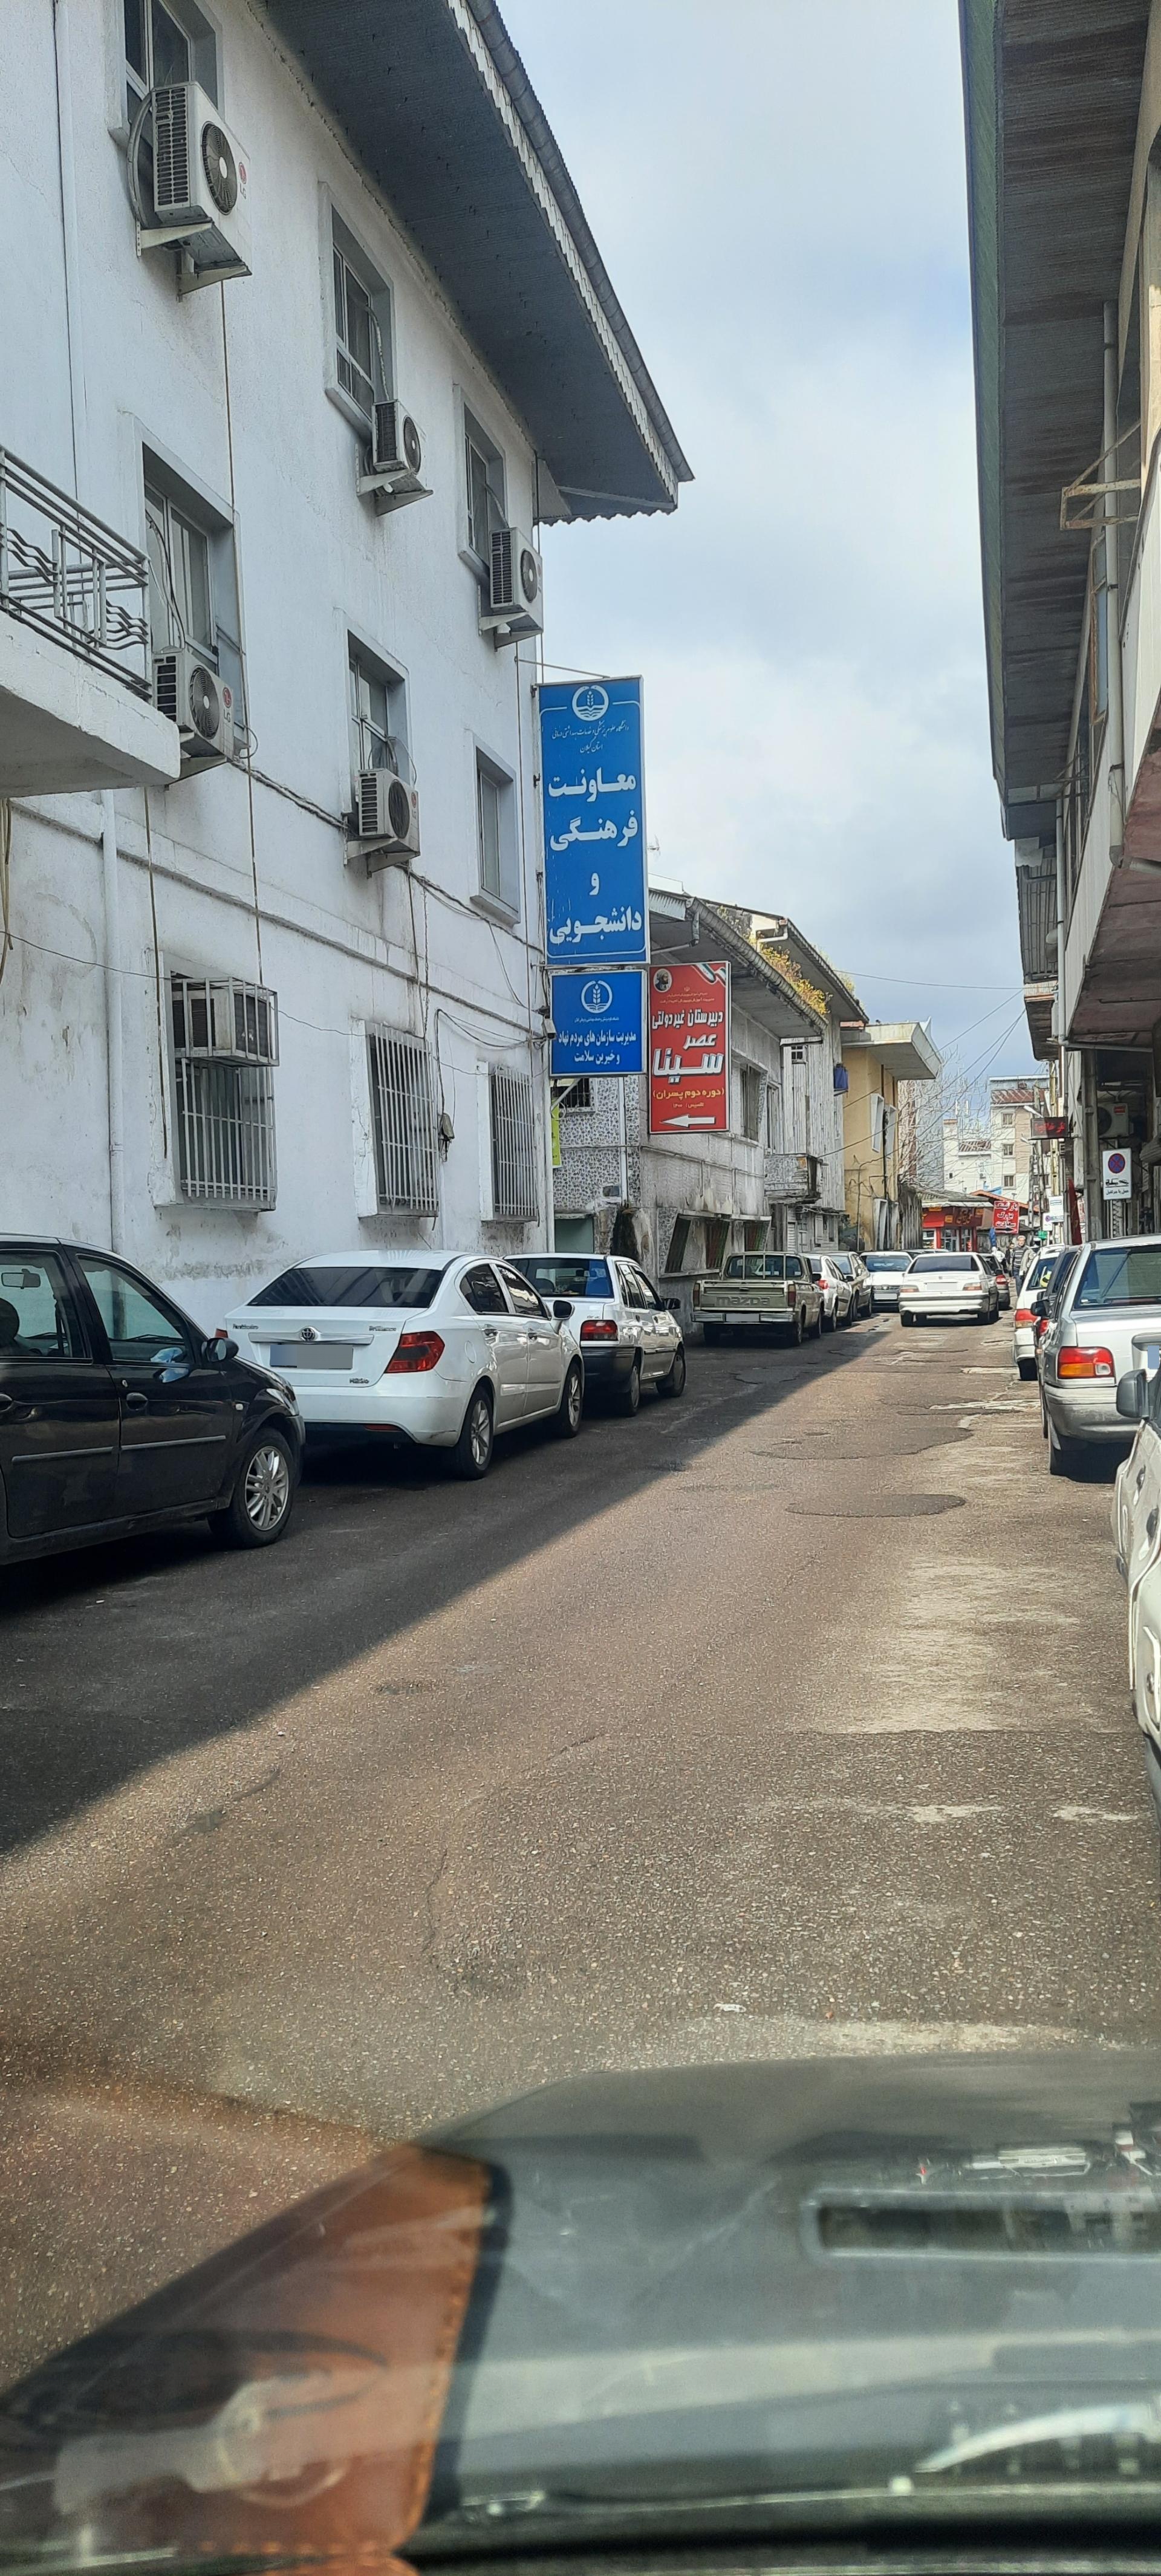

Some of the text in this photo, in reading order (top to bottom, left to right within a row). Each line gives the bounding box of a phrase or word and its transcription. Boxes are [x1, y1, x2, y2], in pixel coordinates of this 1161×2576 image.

[240, 183, 247, 200] LG
[223, 709, 231, 723] LG
[548, 766, 637, 802] معاونت
[550, 810, 639, 851] فرهنگی
[588, 872, 600, 896] و
[549, 905, 643, 945] دانشجویی
[686, 1009, 724, 1027] دبیرستان
[558, 1029, 637, 1047] مدیریت سازمان های مردم نهاد
[683, 1033, 717, 1050] عصر
[574, 1050, 620, 1065] و خیرین سلامت
[652, 1047, 724, 1084] سینا
[684, 1090, 701, 1099] دوم
[716, 1296, 770, 1306] mazda
